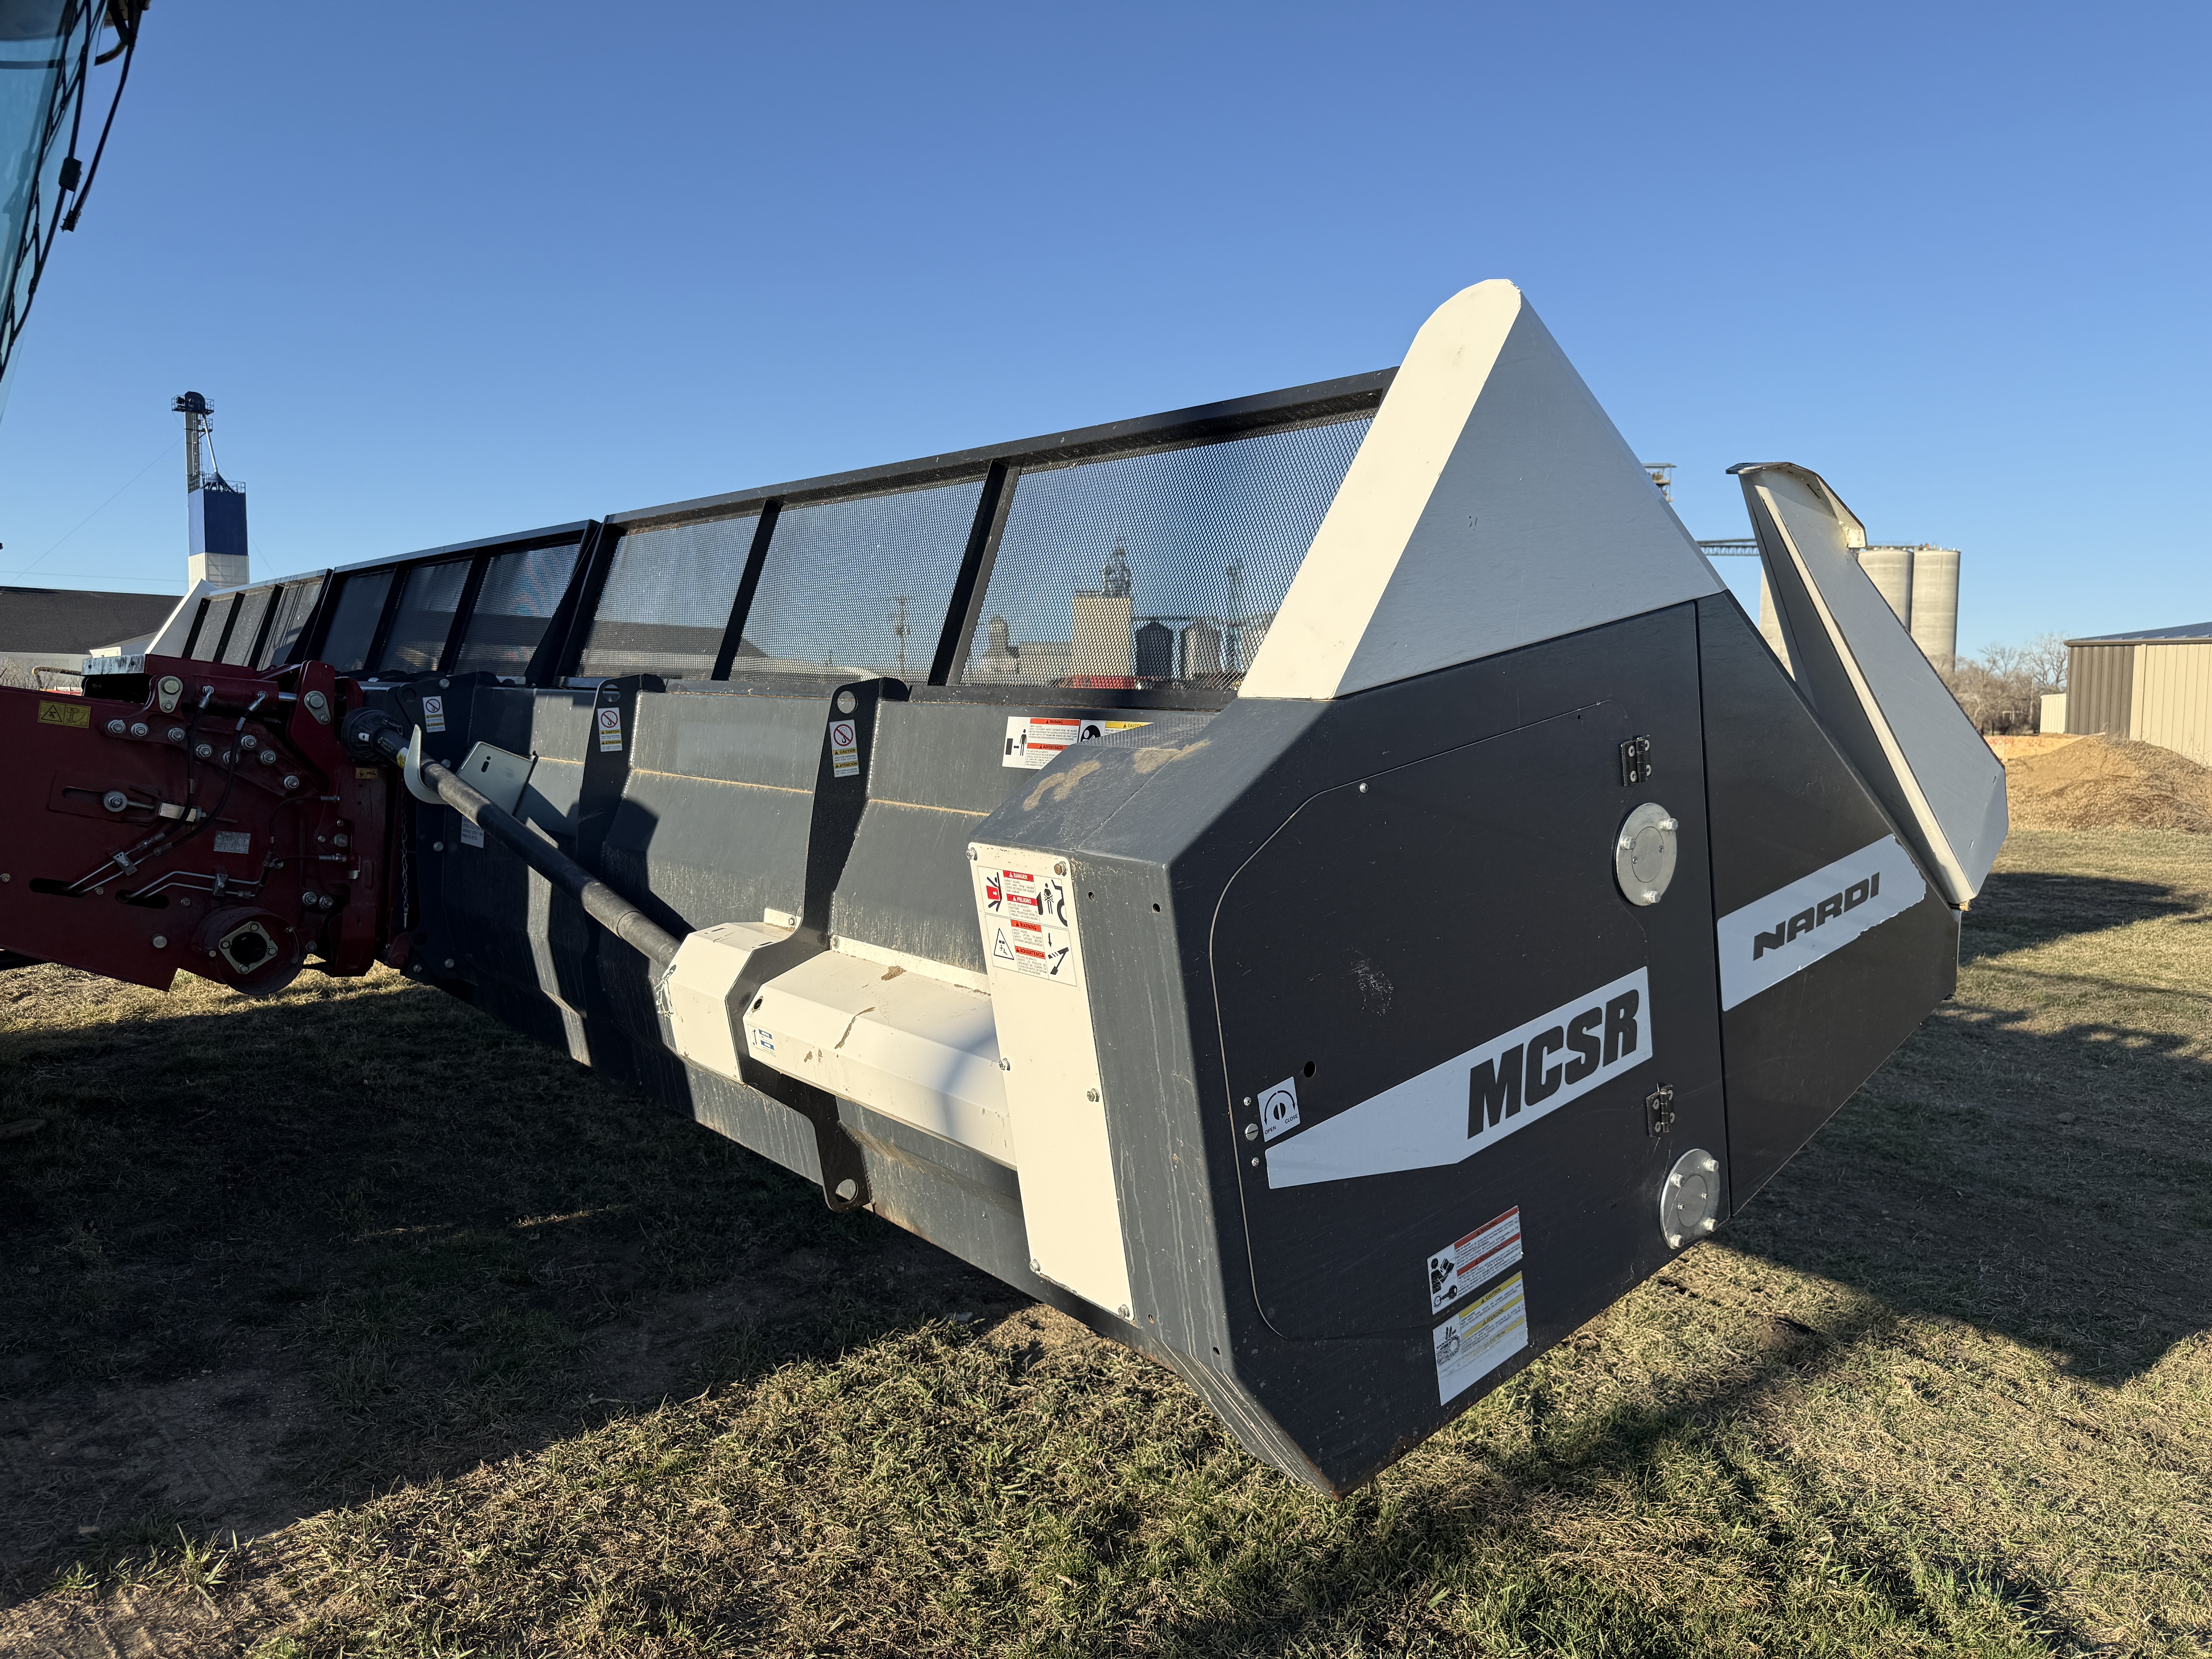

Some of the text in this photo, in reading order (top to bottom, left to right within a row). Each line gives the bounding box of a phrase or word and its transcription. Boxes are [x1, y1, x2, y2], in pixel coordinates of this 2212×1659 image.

[1017, 896, 1032, 904] PELIGRO
[1753, 871, 1880, 961] NARDI
[1020, 948, 1044, 957] ADVERTENCIA
[1467, 989, 1639, 1140] MCSR
[1285, 1113, 1298, 1124] CLOSE
[1265, 1125, 1276, 1135] OPEN
[1486, 1287, 1501, 1300] CAUTION
